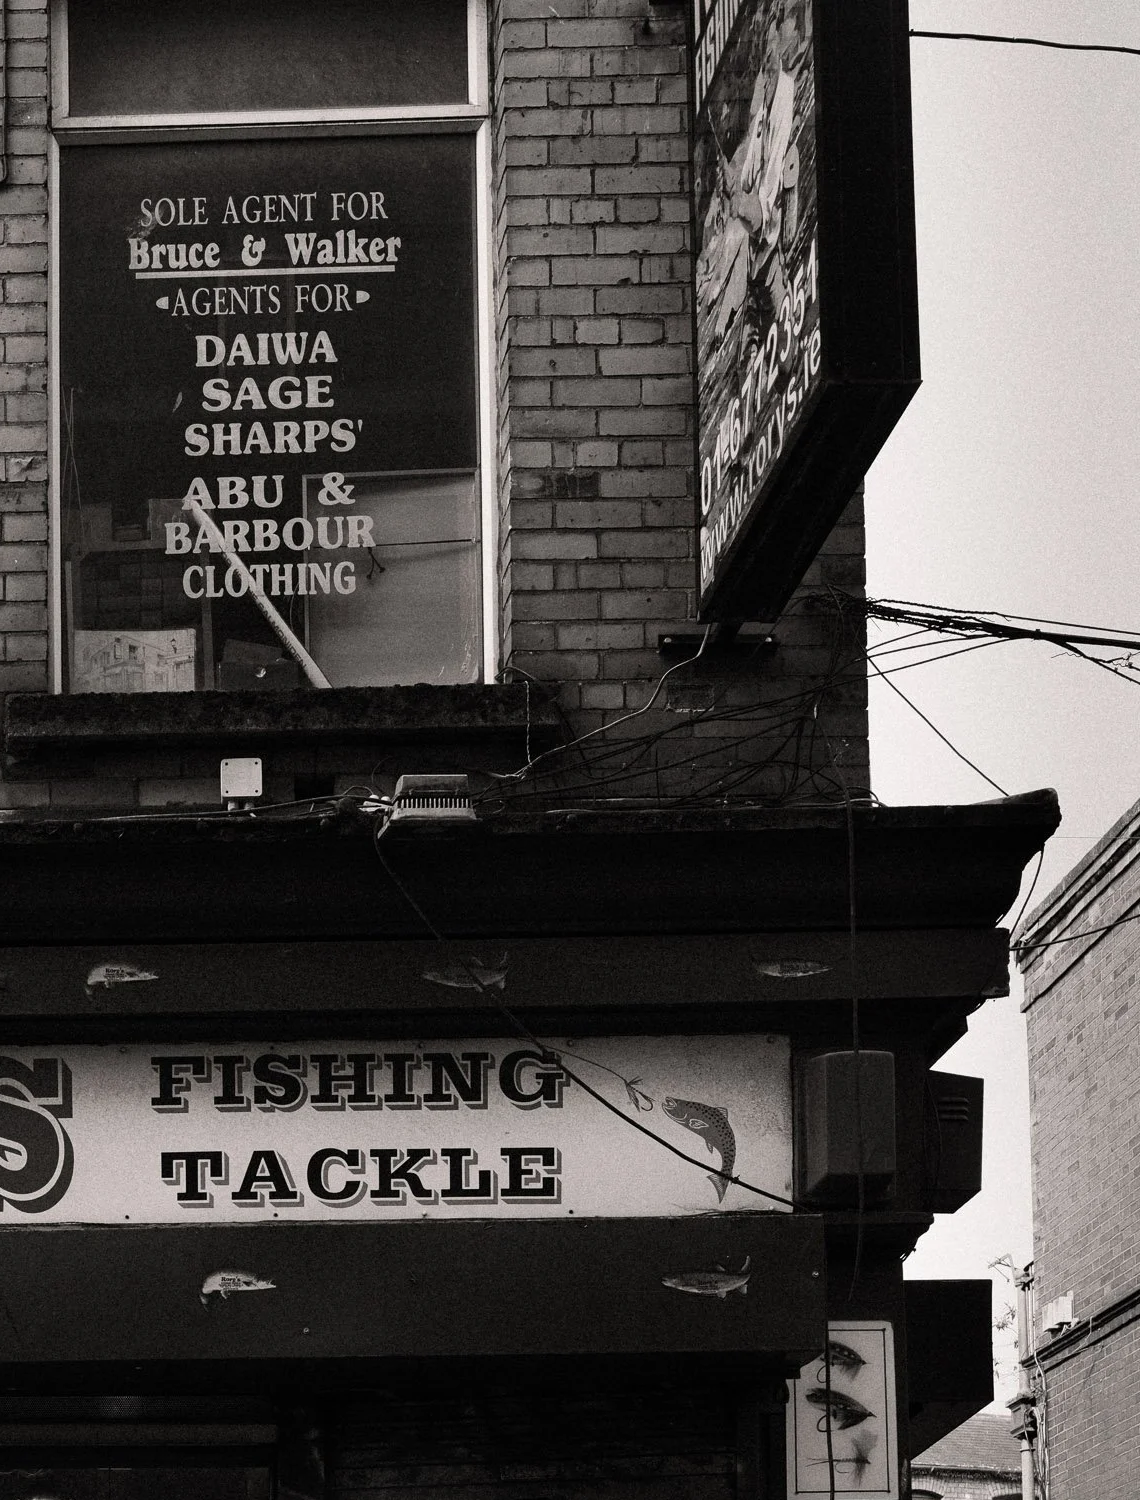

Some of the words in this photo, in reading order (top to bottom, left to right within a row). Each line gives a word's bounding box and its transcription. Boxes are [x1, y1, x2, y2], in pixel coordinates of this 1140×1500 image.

[140, 196, 209, 229] SOLE
[222, 192, 318, 226] AGENT
[331, 191, 388, 222] FOR
[128, 236, 221, 271] Bruce
[241, 235, 266, 267] &
[286, 229, 402, 266] Walker
[171, 286, 281, 317] AGENTS
[295, 283, 353, 314] FOR
[195, 330, 338, 368] DAIWA
[202, 375, 335, 412] SAGE
[184, 419, 363, 457] SHARPS'
[181, 475, 284, 511] ABU
[318, 472, 356, 506] &
[164, 514, 377, 556] BARBOUR
[182, 561, 357, 599] CLOTHING
[150, 1049, 571, 1114] FISHING
[160, 1146, 563, 1210] TACKLE
